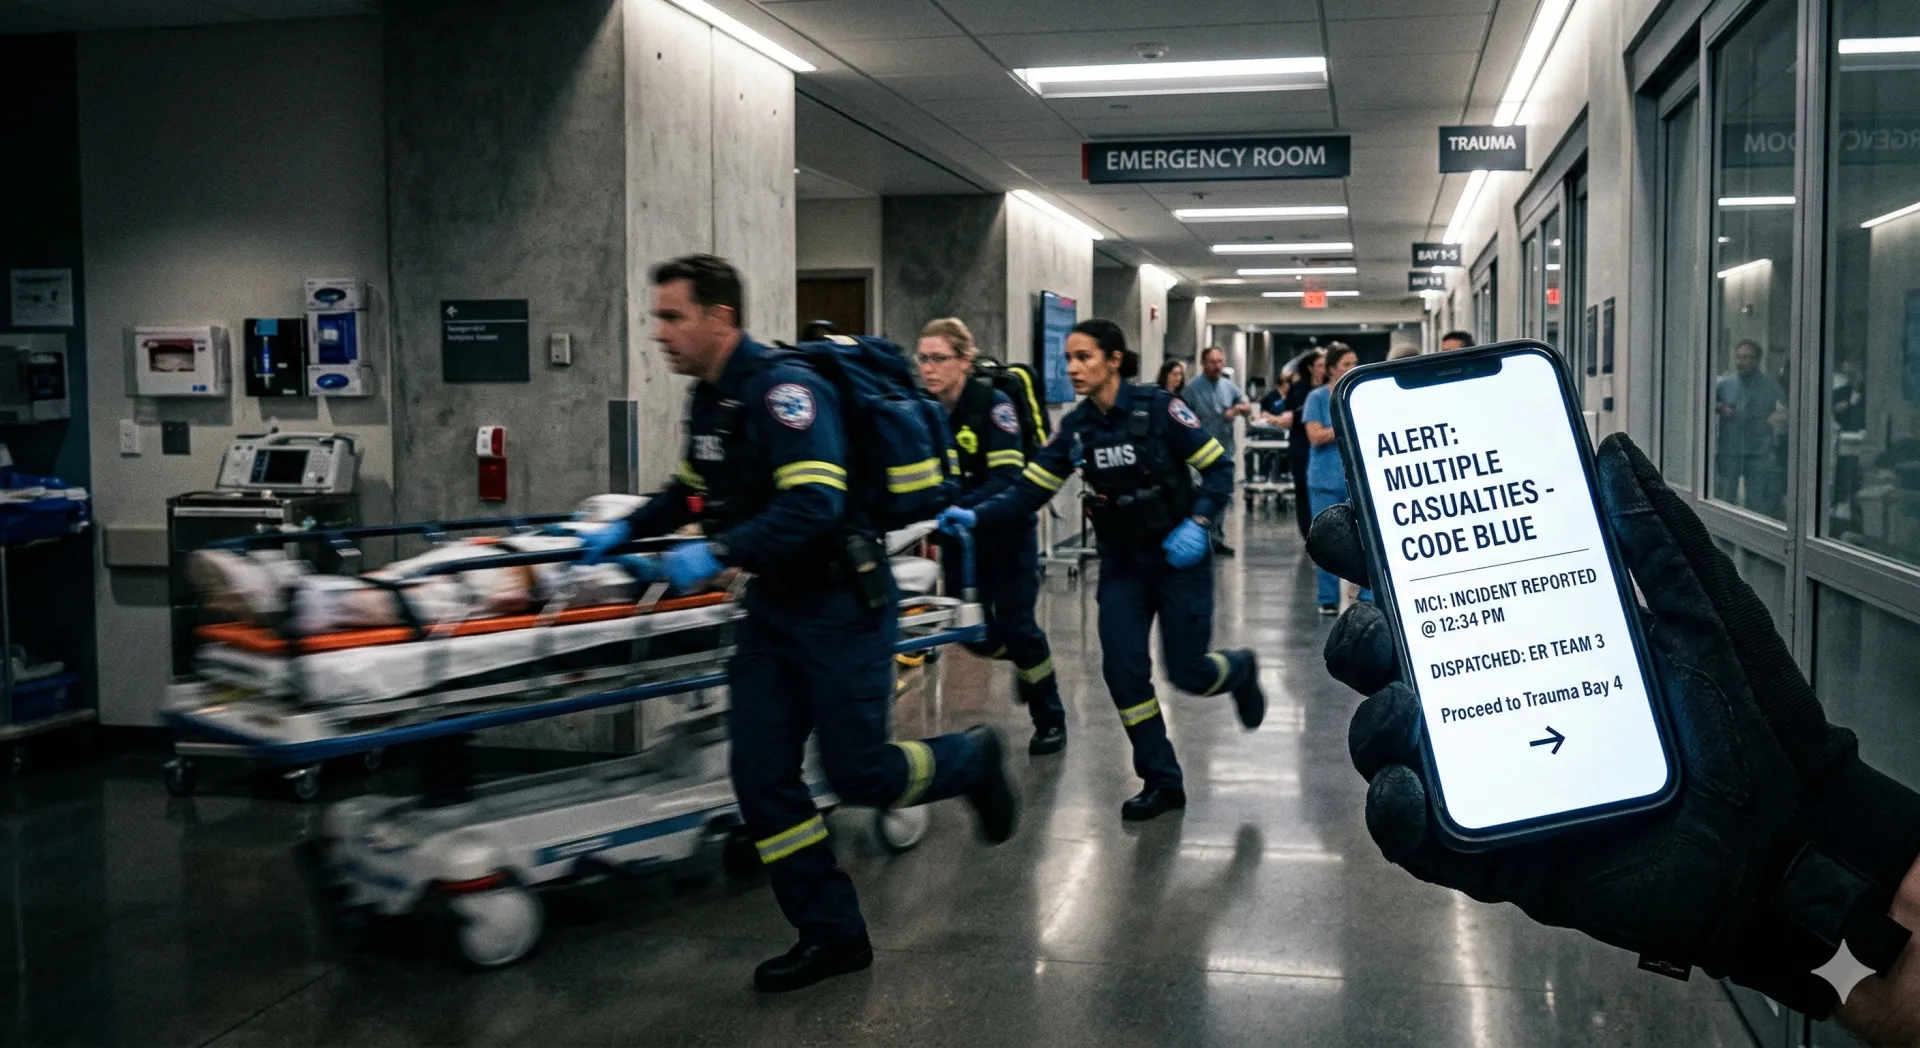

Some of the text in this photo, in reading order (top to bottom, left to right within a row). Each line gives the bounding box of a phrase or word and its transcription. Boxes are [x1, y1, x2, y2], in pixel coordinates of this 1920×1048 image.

[1106, 145, 1326, 171] EMERGENCY ROOM
[1447, 135, 1517, 151] TRAUMA
[1417, 249, 1440, 261] BAY
[1094, 443, 1138, 469] EMS
[1378, 422, 1459, 458] ALERT:
[1383, 449, 1503, 492] MULTIPLE
[1392, 479, 1539, 527] CASUALTIES
[1401, 515, 1538, 562] CODE BLUE
[1414, 568, 1597, 614] MCI: INCIDENT REPORTED
[1421, 606, 1506, 639] @ 12:34 PM
[1430, 633, 1605, 680] DISPATCHED: ER TEAM 3
[1440, 675, 1623, 724] Proceed to Trauma Bay 4
